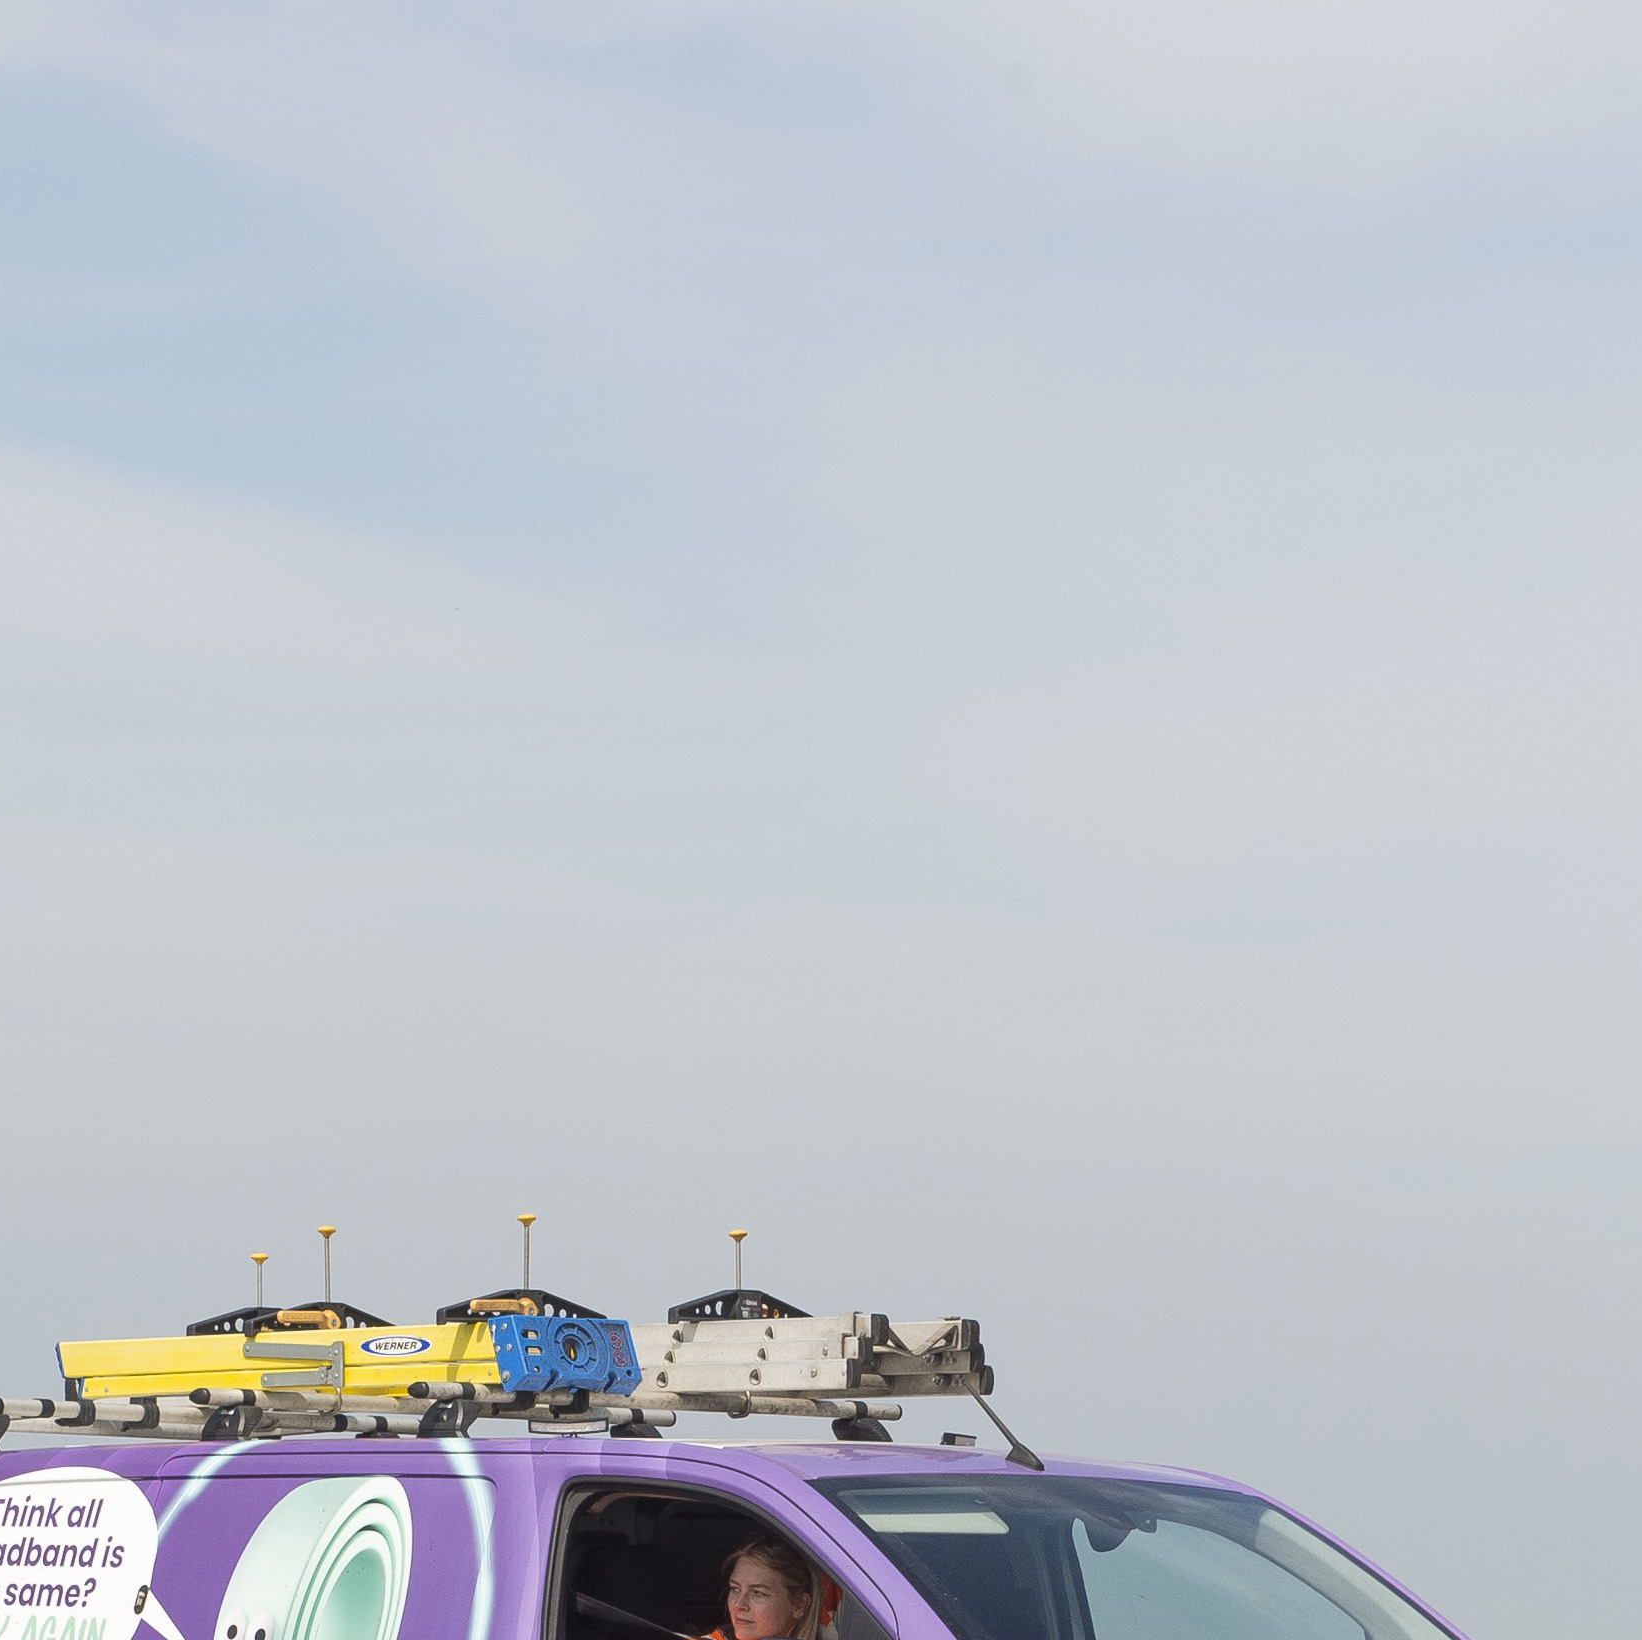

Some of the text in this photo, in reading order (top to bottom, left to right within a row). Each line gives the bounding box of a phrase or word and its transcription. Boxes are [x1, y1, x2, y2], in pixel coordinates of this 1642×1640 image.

[375, 1341, 418, 1351] WERNER
[67, 1498, 104, 1528] all
[102, 1536, 125, 1568] is
[4, 1577, 97, 1608] same?
